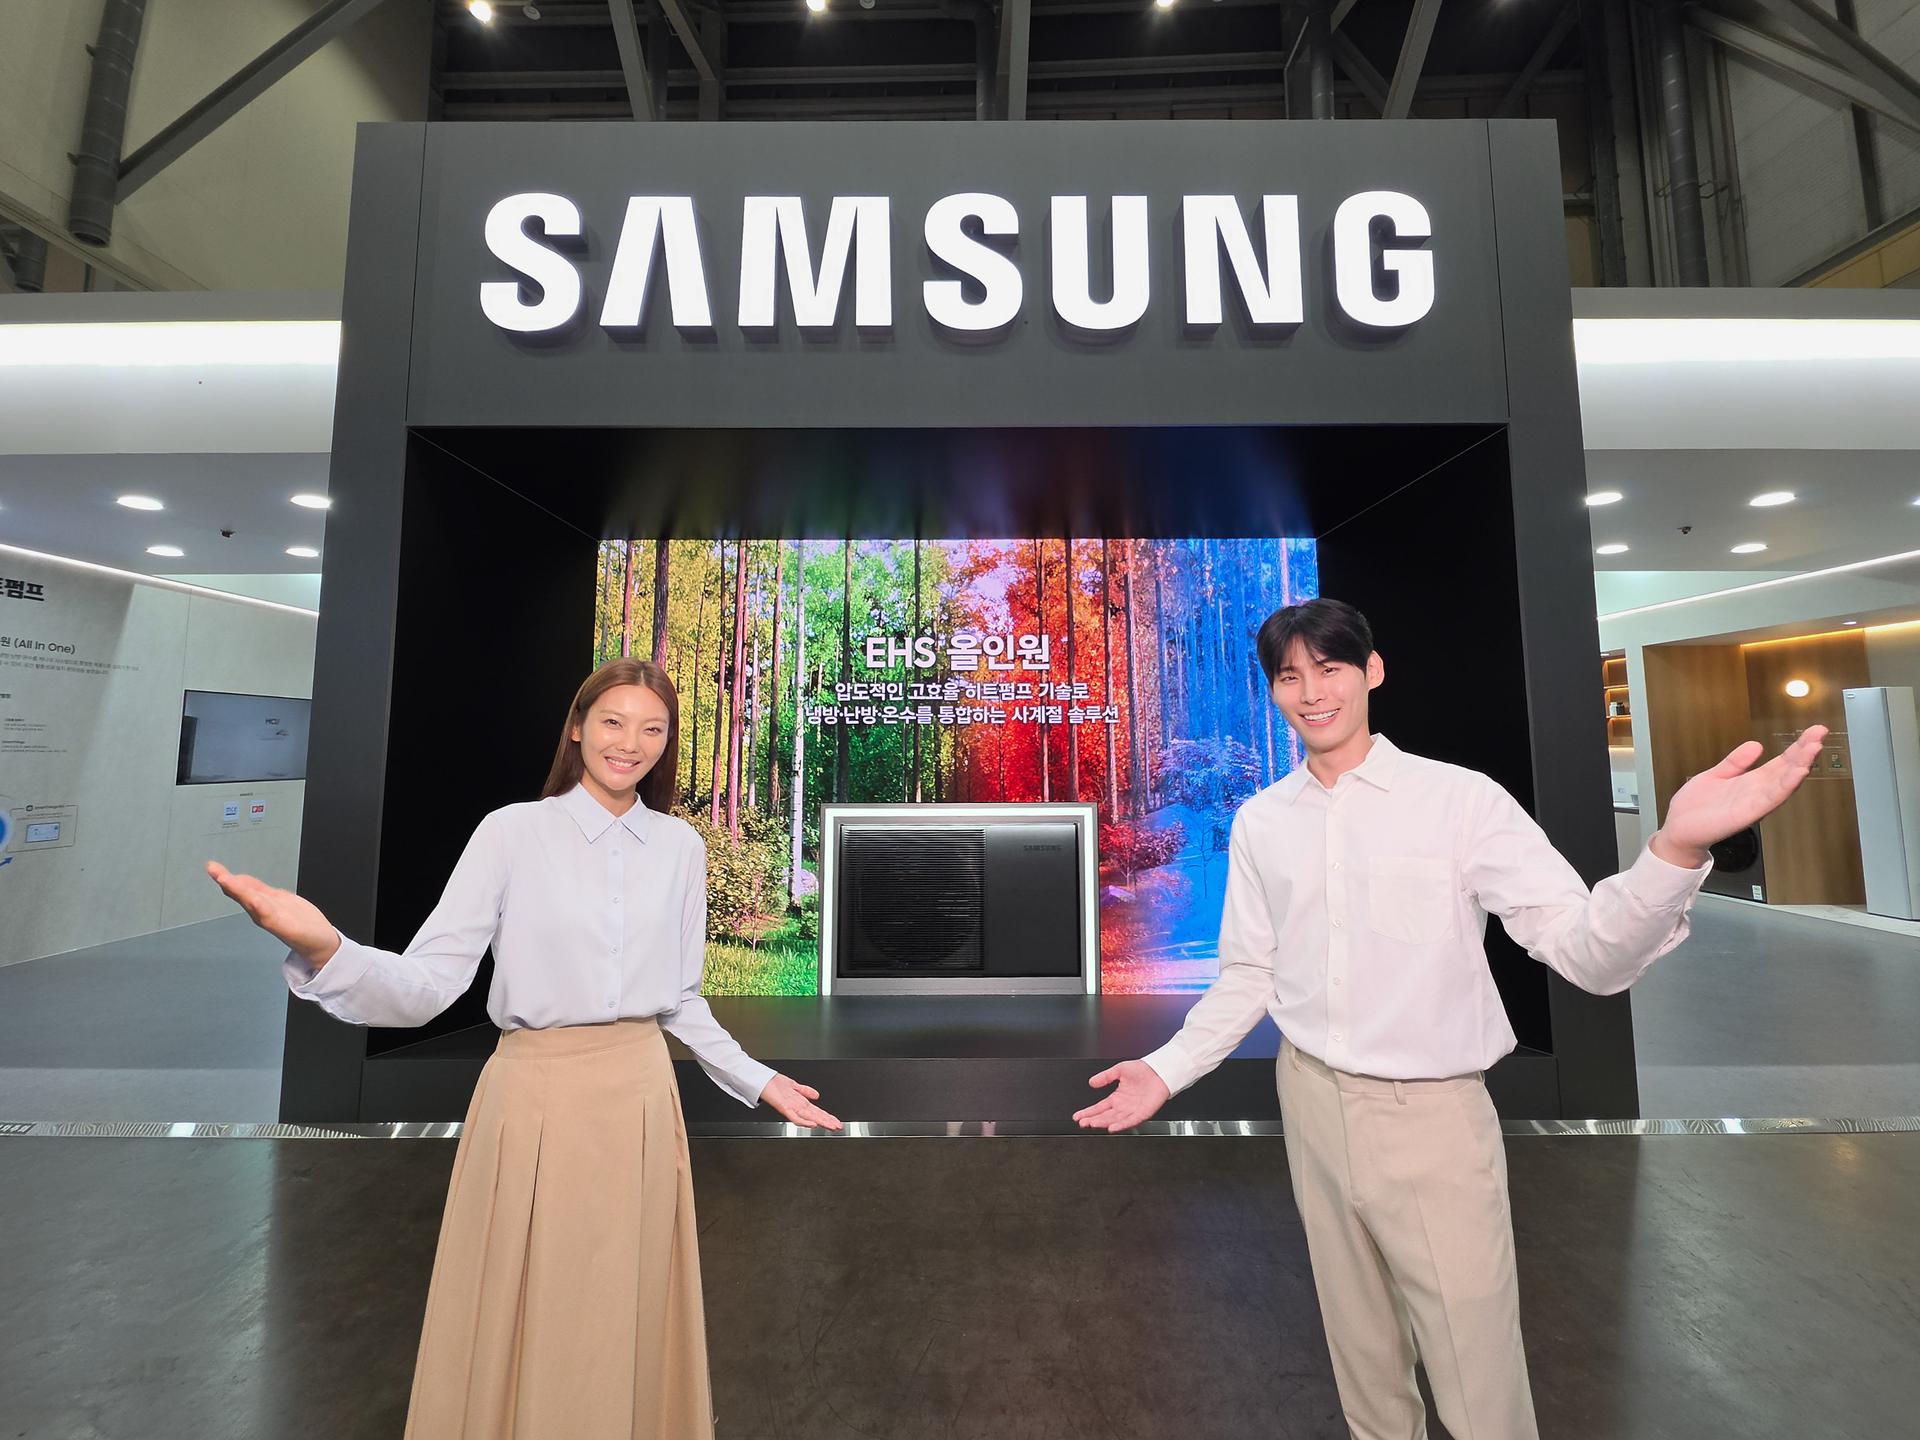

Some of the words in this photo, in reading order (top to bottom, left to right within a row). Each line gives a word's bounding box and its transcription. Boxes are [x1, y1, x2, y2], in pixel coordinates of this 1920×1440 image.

[480, 190, 1436, 333] SAMSUNG
[0, 577, 45, 601] 펌프
[14, 638, 33, 649] (All
[48, 642, 76, 655] One)
[866, 636, 937, 668] EHS
[946, 634, 1051, 671] 올인원
[834, 682, 903, 701] 압도적인
[907, 682, 961, 701] 고효율
[965, 682, 1034, 701] 히트펌프
[1038, 682, 1090, 701] 기술로
[937, 705, 1007, 725] 통합하는
[1011, 705, 1063, 725] 사계절
[1067, 705, 1121, 725] 솔루션
